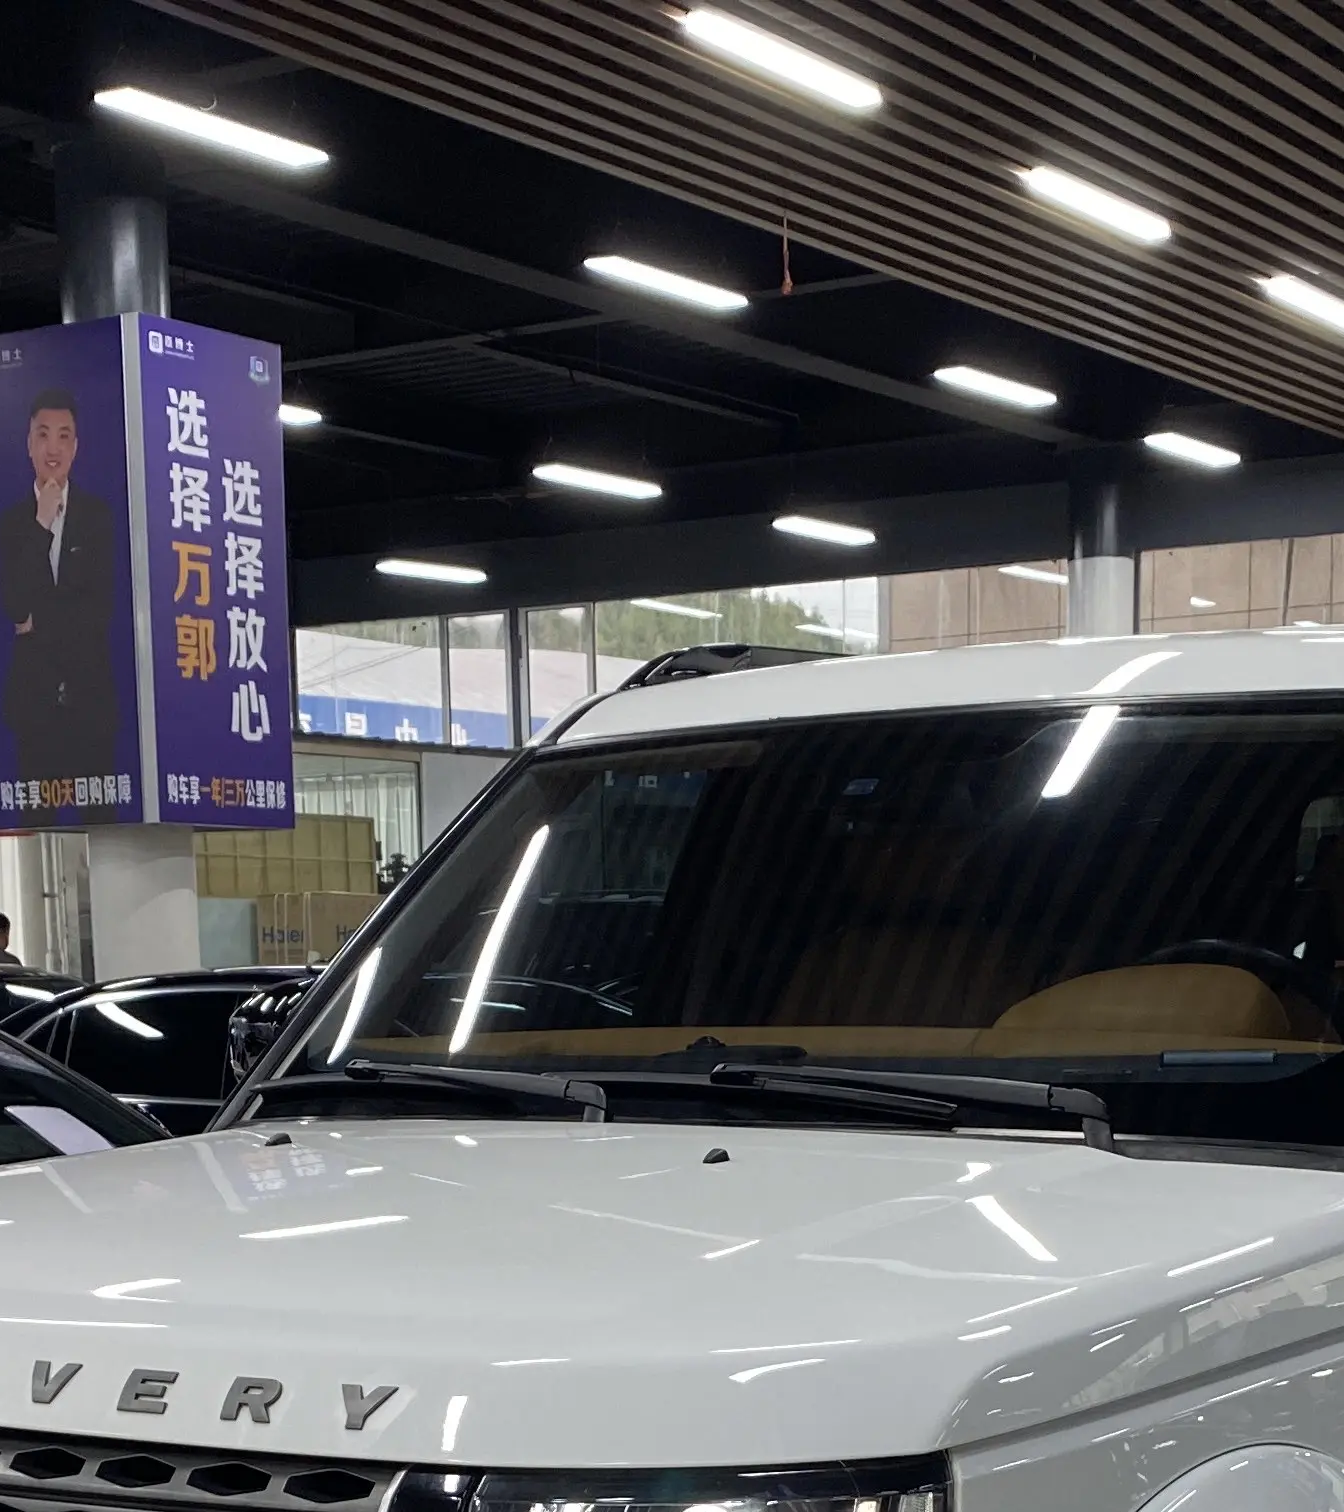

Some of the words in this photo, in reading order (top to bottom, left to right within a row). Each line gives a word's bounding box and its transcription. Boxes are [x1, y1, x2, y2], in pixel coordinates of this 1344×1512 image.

[165, 386, 217, 682] 选择万郭
[221, 458, 270, 743] 选择放心
[0, 774, 132, 811] 购车享90天回购保障
